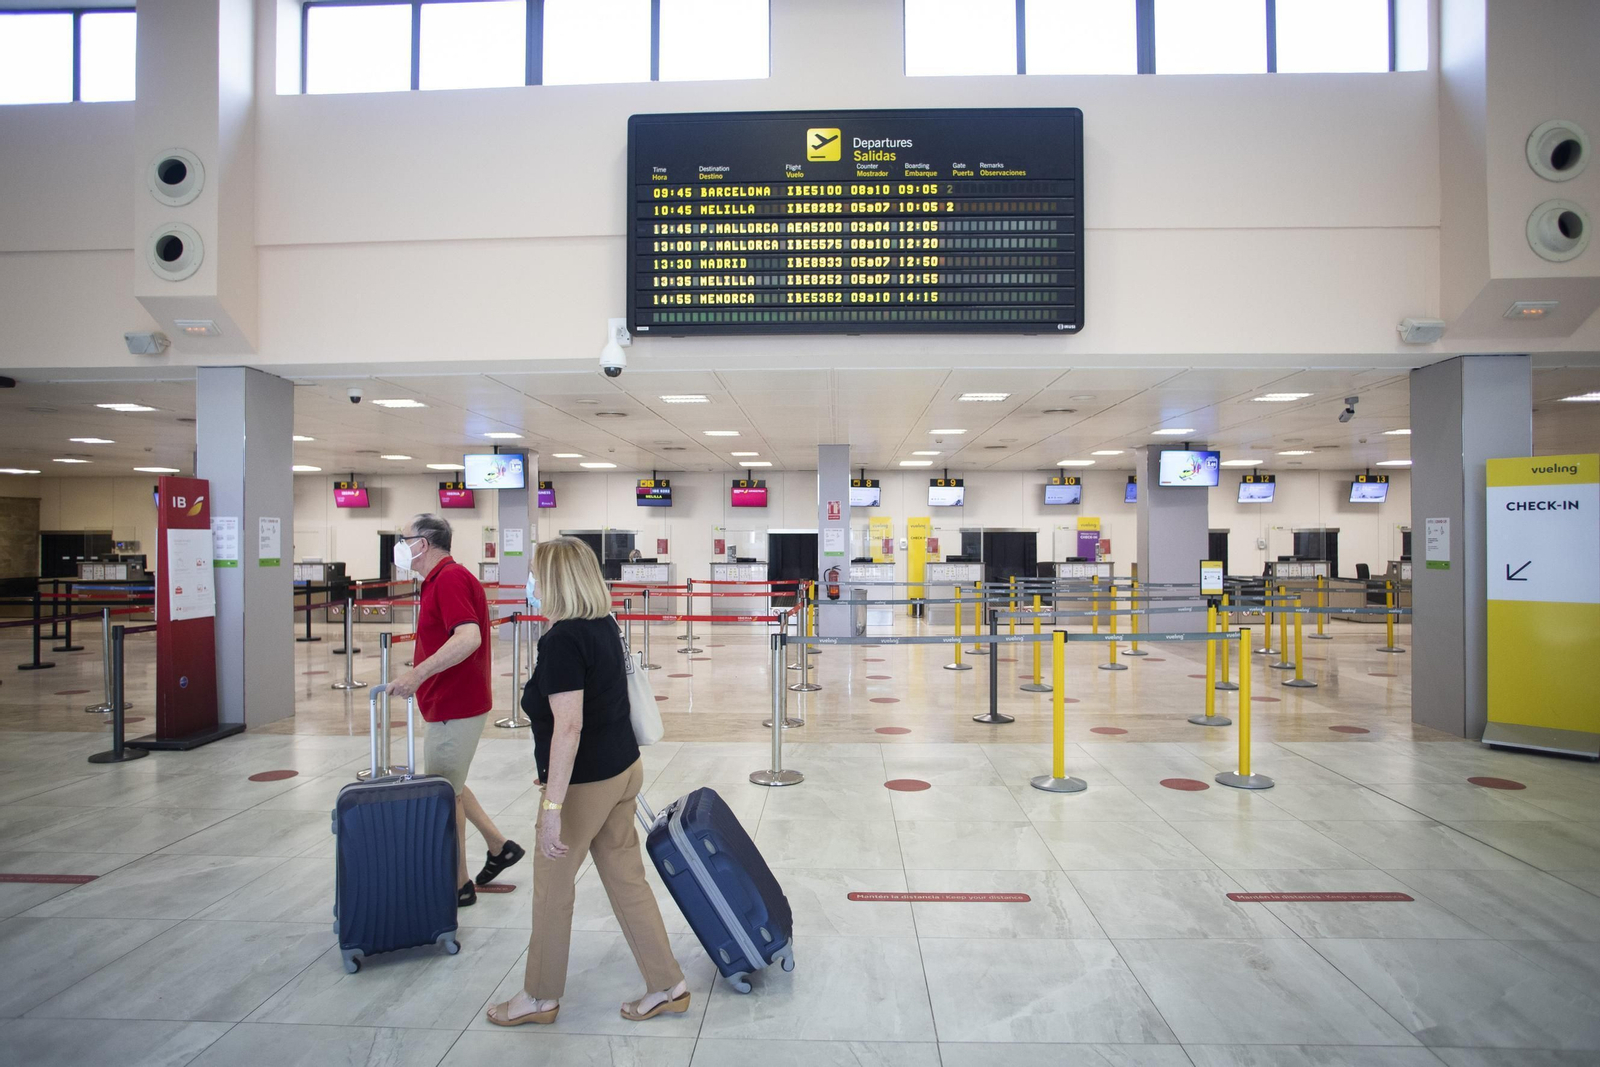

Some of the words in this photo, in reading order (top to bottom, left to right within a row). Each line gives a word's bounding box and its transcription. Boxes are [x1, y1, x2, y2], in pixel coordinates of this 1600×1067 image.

[853, 138, 912, 150] Departures
[854, 150, 896, 161] Salidas
[654, 188, 692, 198] 09:45
[700, 186, 771, 197] BARCELONA
[787, 185, 842, 196] IBE5100
[851, 185, 890, 195] 08a10
[899, 184, 938, 194] 09:05
[947, 185, 953, 194] 2
[654, 205, 692, 216] 10:45
[700, 204, 755, 215] MELILLA
[787, 203, 842, 213] IBE8282
[851, 203, 890, 212] 05a07
[899, 202, 938, 212] 10:05
[947, 202, 954, 212] 2
[654, 224, 692, 234] 12:45
[787, 222, 842, 233] AEA5200
[851, 222, 890, 232] 03a04
[899, 221, 938, 232] 12:05
[654, 241, 692, 252] 13:00
[787, 239, 842, 250] IBE5575
[851, 239, 890, 249] 08a10
[899, 238, 938, 248] 12:20
[654, 259, 692, 269] 13:30
[700, 258, 746, 269] MADRID
[787, 257, 842, 267] IBE8933
[851, 257, 890, 267] 05a07
[899, 256, 938, 267] 12:50
[654, 276, 692, 286] 13:35
[700, 275, 755, 286] MELILLA
[787, 275, 842, 285] IBE8252
[851, 274, 890, 285] 05a07
[899, 274, 938, 284] 12:55
[654, 294, 692, 304] 14:55
[700, 293, 755, 304] MENORCA
[787, 293, 842, 303] IBE5362
[851, 292, 890, 302] 09a10
[899, 292, 938, 302] 14:15
[1532, 463, 1578, 475] vueling
[173, 496, 186, 508] IB
[1506, 501, 1579, 511] CHECK-IN
